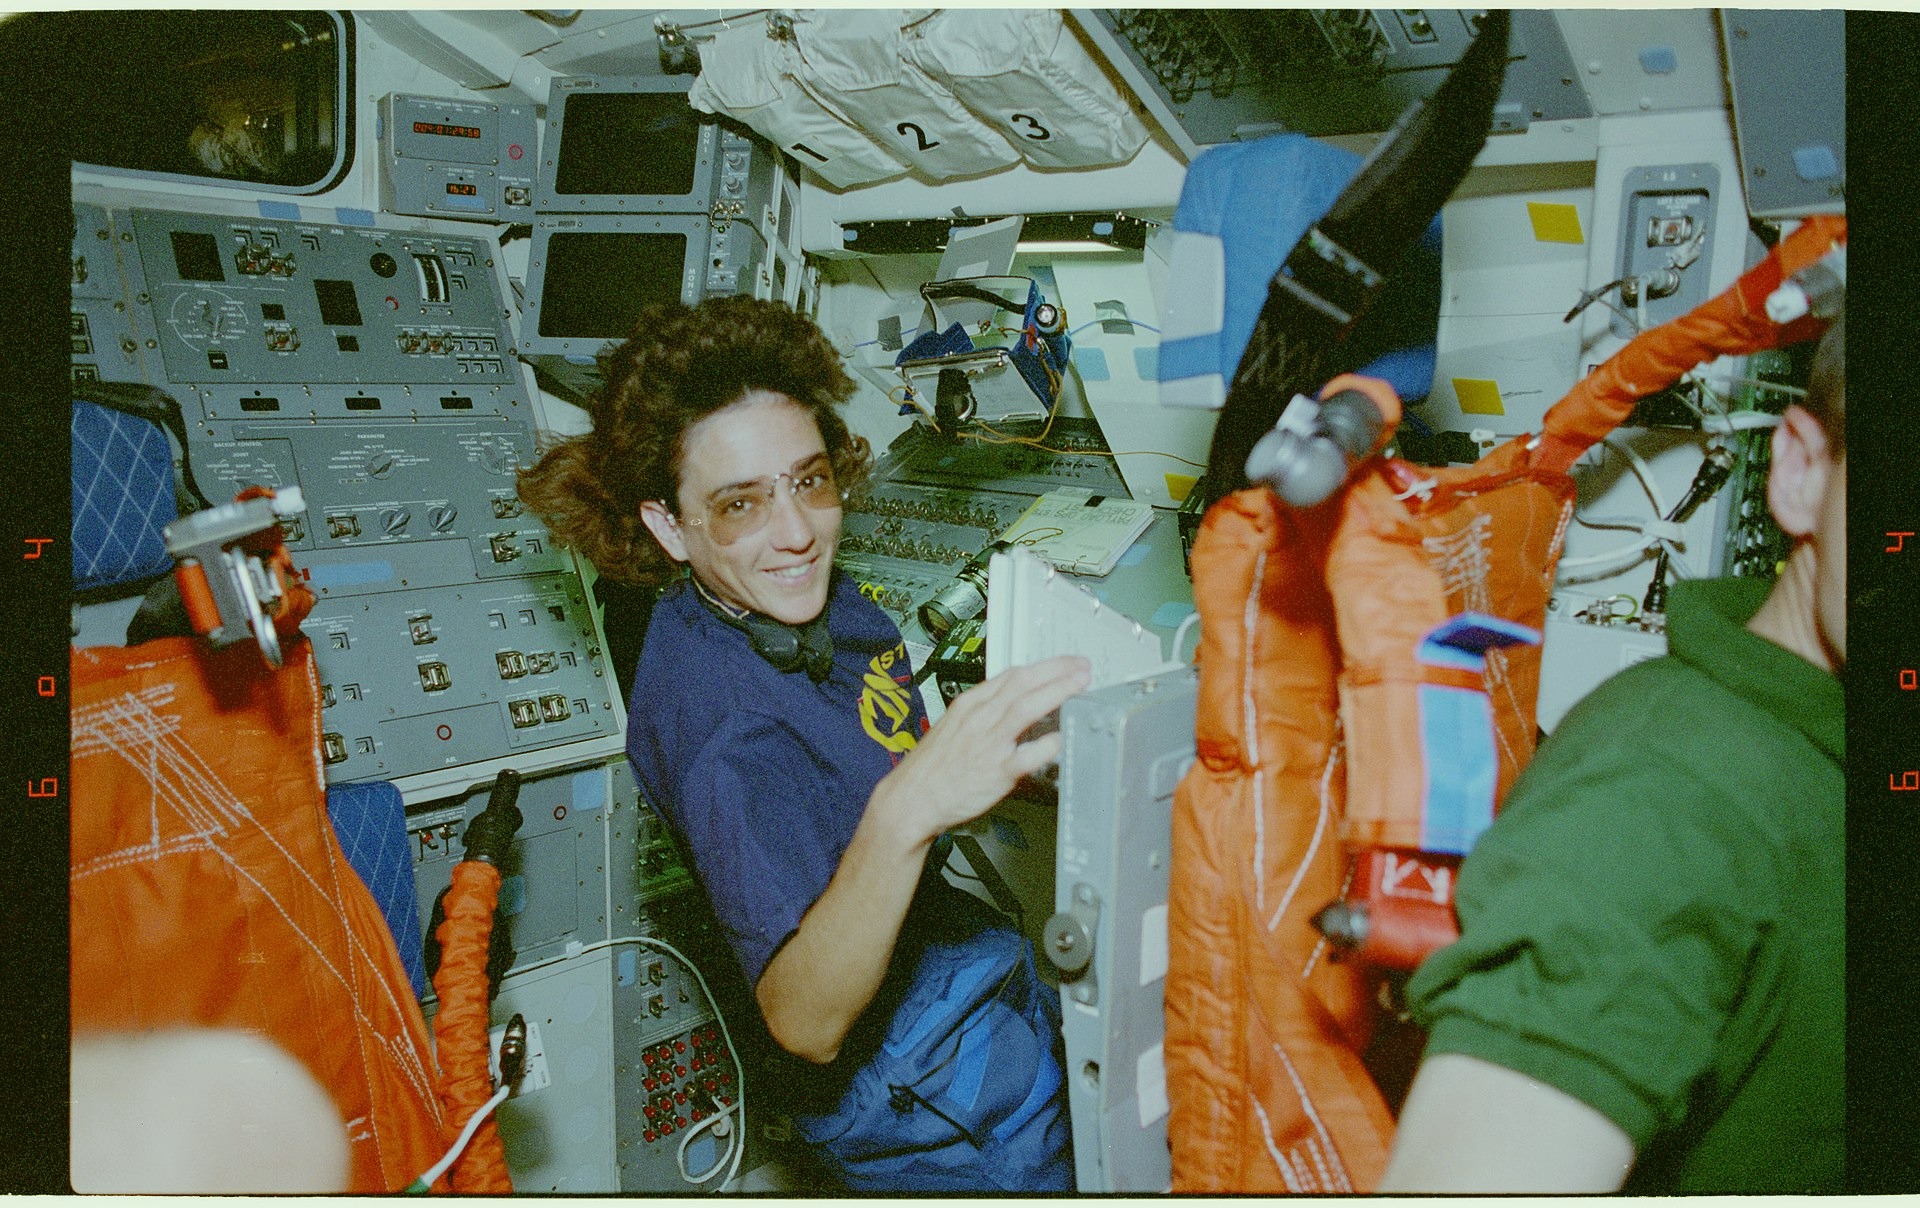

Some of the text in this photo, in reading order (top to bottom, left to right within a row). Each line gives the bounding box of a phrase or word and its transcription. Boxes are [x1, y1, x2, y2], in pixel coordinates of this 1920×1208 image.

[703, 125, 711, 145] MON
[896, 121, 941, 152] 2
[1011, 113, 1051, 141] 3
[792, 142, 830, 163] 1
[687, 268, 696, 288] MON
